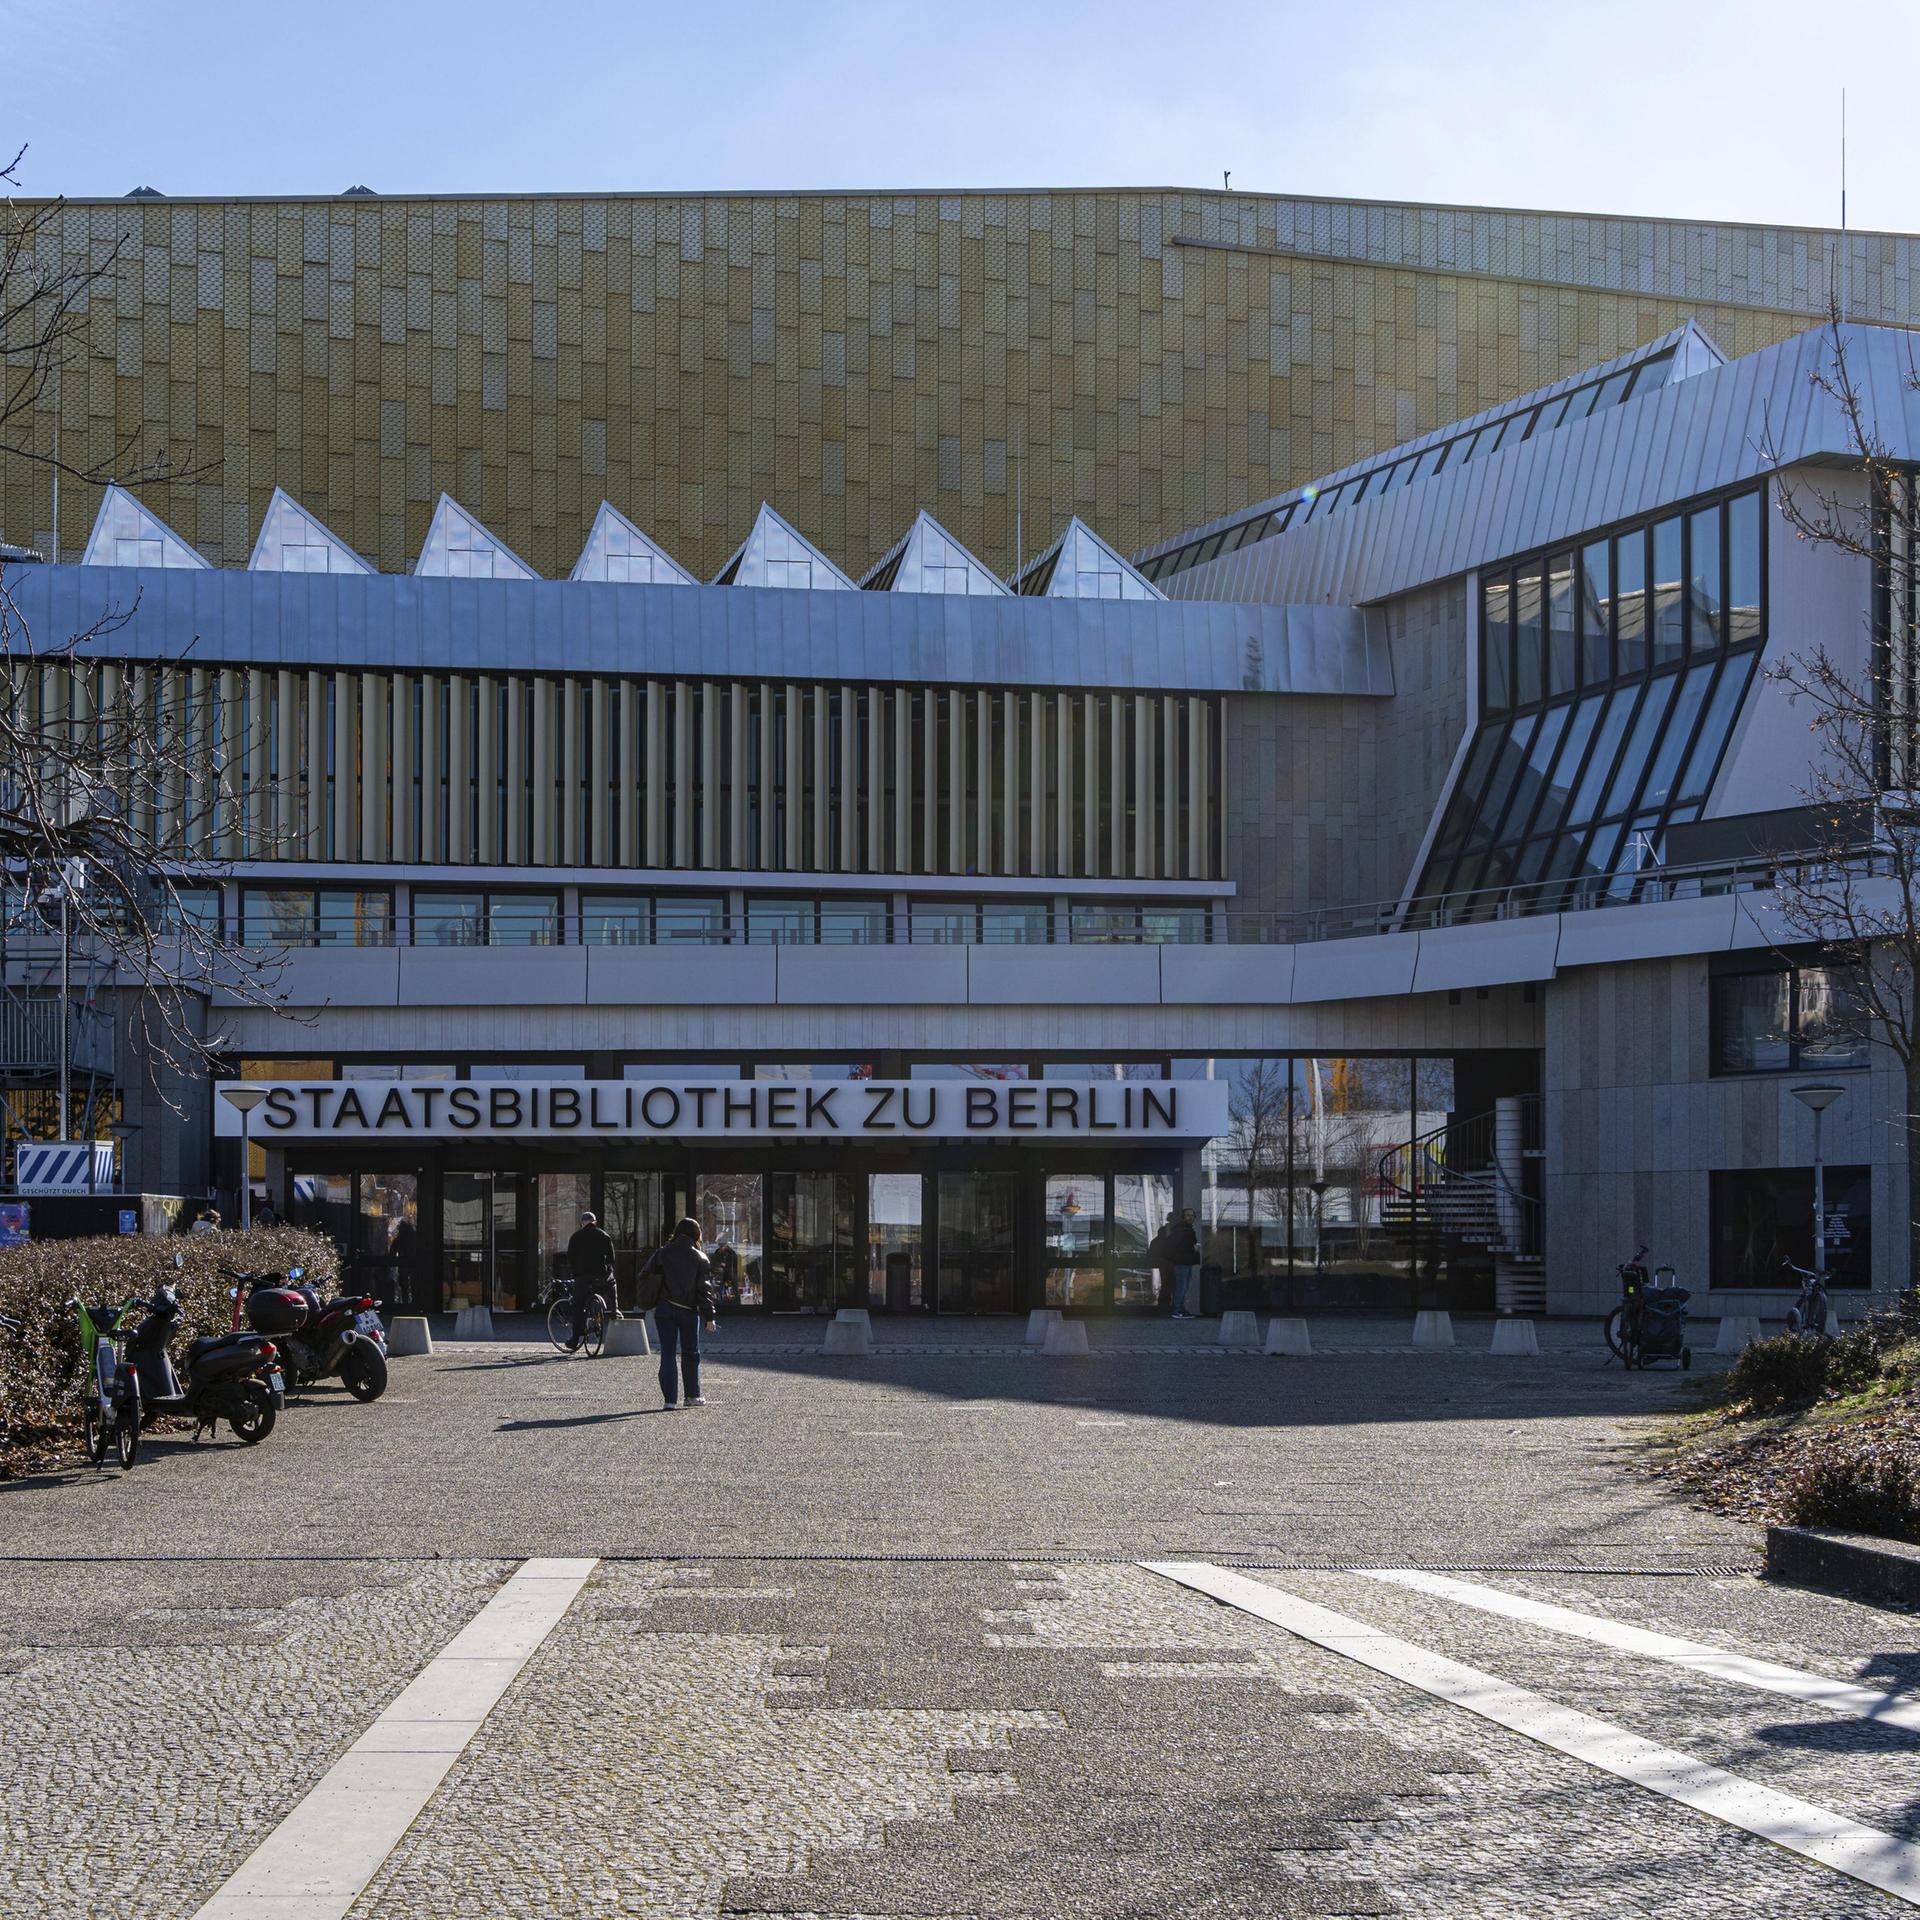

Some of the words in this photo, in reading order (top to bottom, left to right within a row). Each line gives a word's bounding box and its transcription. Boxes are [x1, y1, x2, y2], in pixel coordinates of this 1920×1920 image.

[264, 1087, 839, 1129] STAATSBIBLIOTHEK
[862, 1087, 936, 1129] ZU
[965, 1087, 1177, 1129] BERLIN
